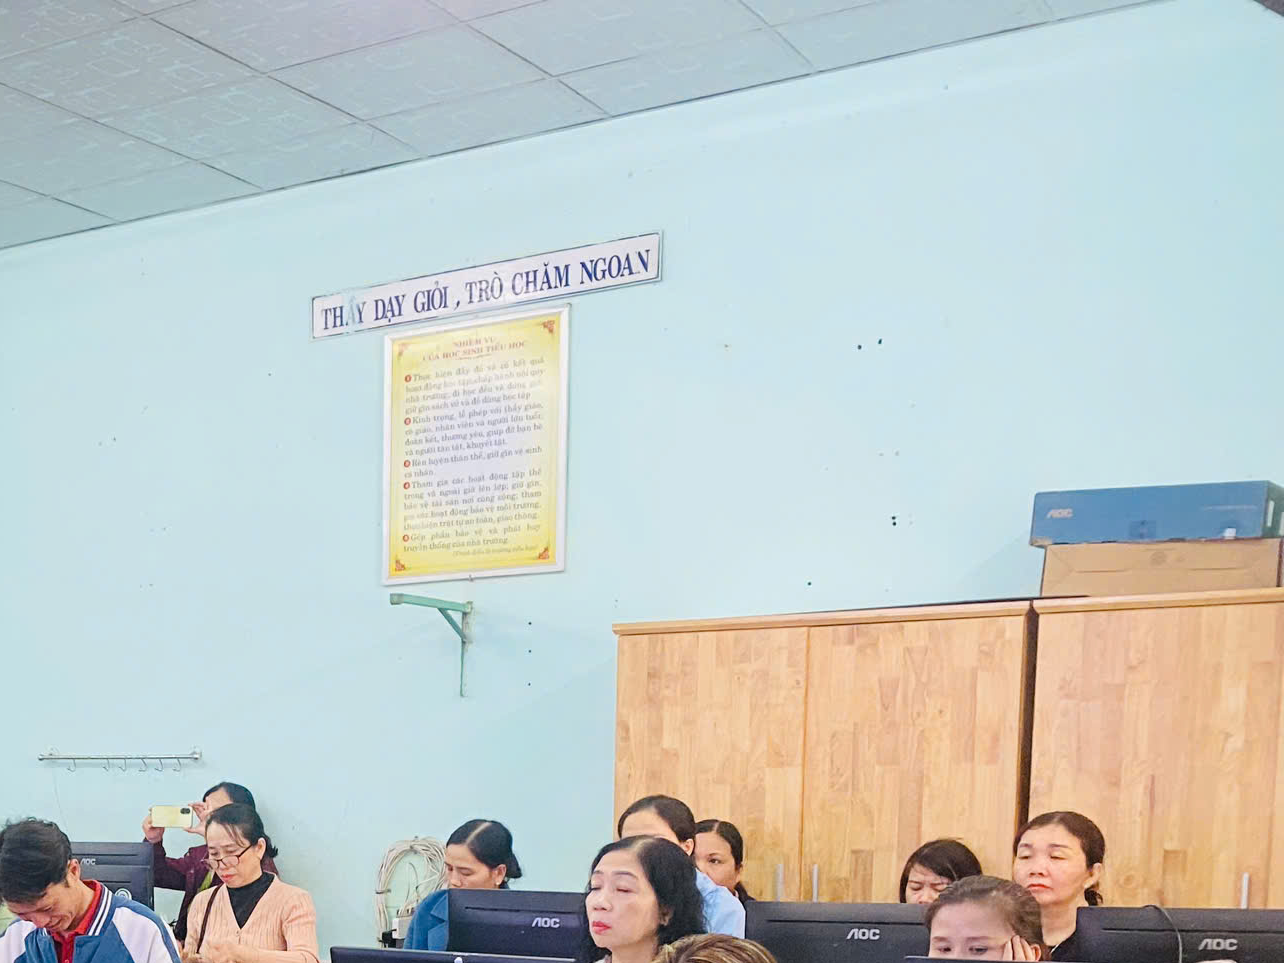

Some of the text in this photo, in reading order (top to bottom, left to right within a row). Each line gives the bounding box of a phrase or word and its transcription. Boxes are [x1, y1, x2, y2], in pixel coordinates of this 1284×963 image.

[373, 294, 406, 323] DẠY
[413, 280, 449, 314] GIỎI
[465, 271, 504, 305] TRÒ
[511, 260, 571, 296] CHĂM
[579, 249, 651, 285] NGOAN
[80, 857, 96, 865] AOC
[532, 917, 560, 928] AOC
[846, 928, 880, 940] AOC
[1198, 938, 1238, 951] AOC
